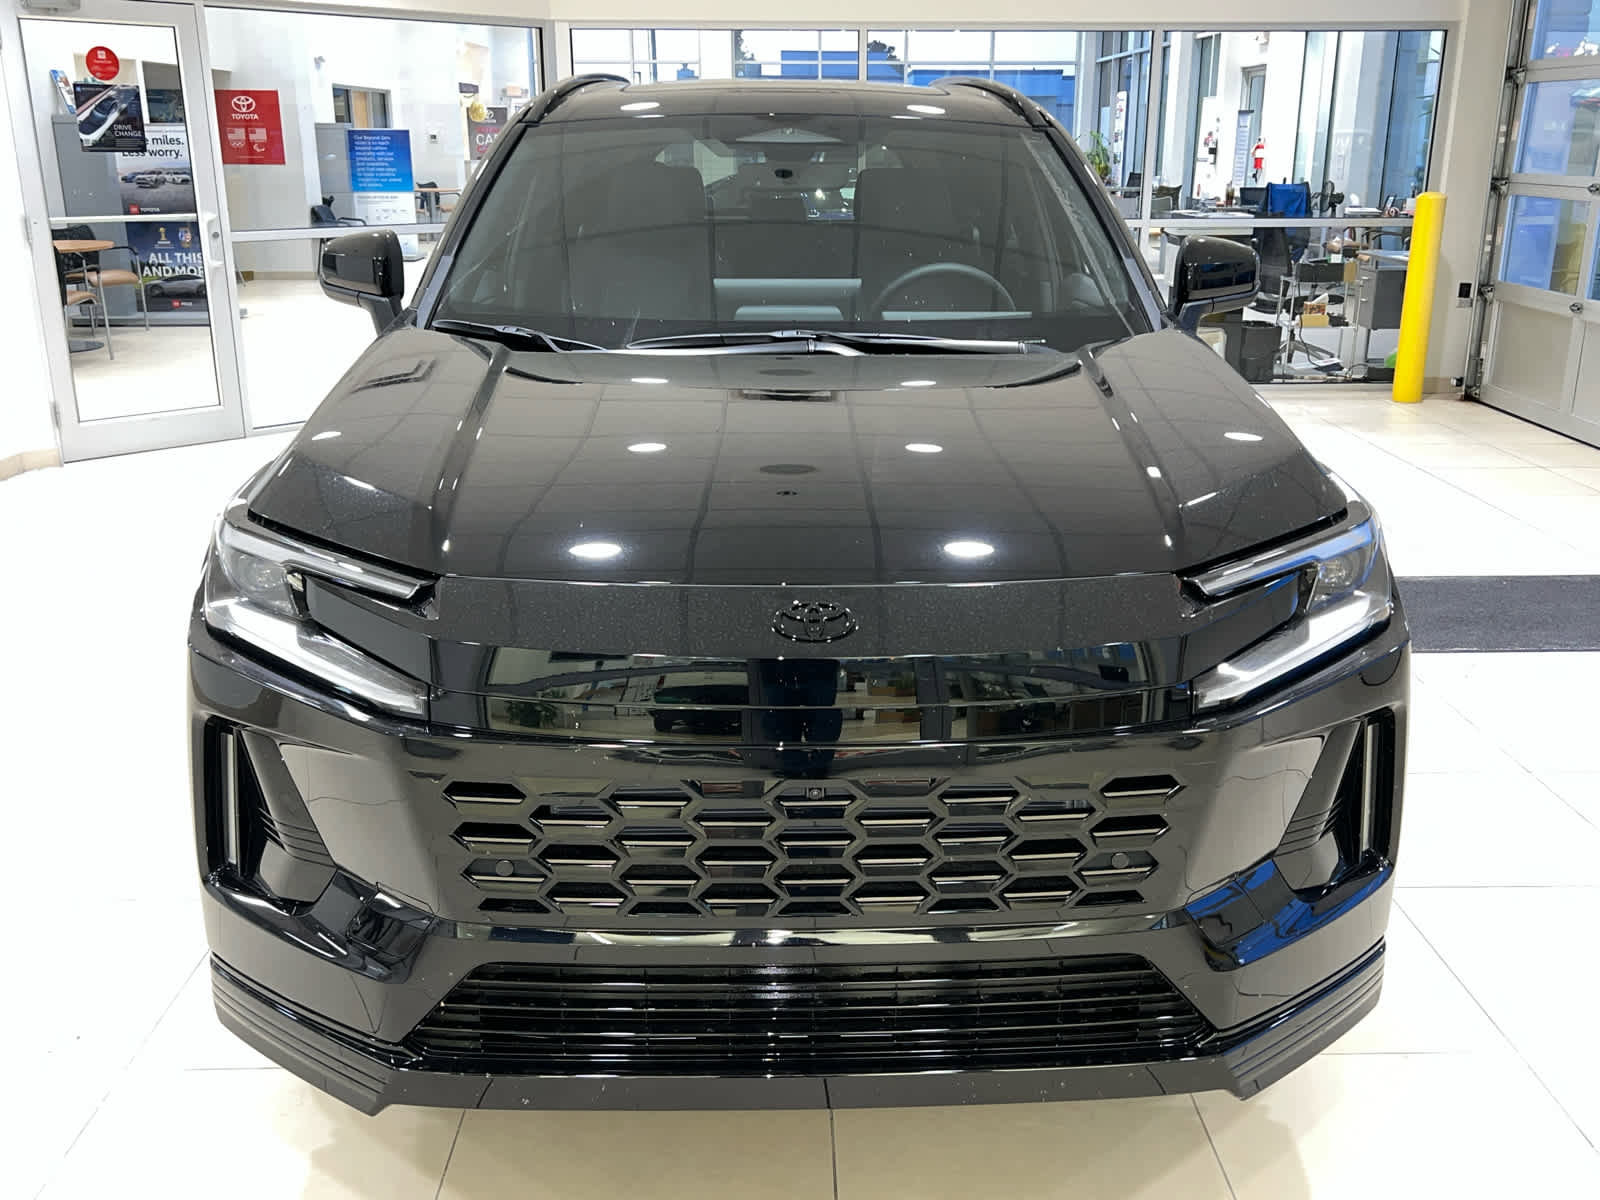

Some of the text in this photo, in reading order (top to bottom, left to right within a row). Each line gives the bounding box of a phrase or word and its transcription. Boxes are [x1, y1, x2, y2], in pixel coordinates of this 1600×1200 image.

[152, 134, 184, 145] miles.
[148, 149, 182, 159] worry.
[148, 252, 172, 264] ALL
[143, 266, 172, 277] AND
